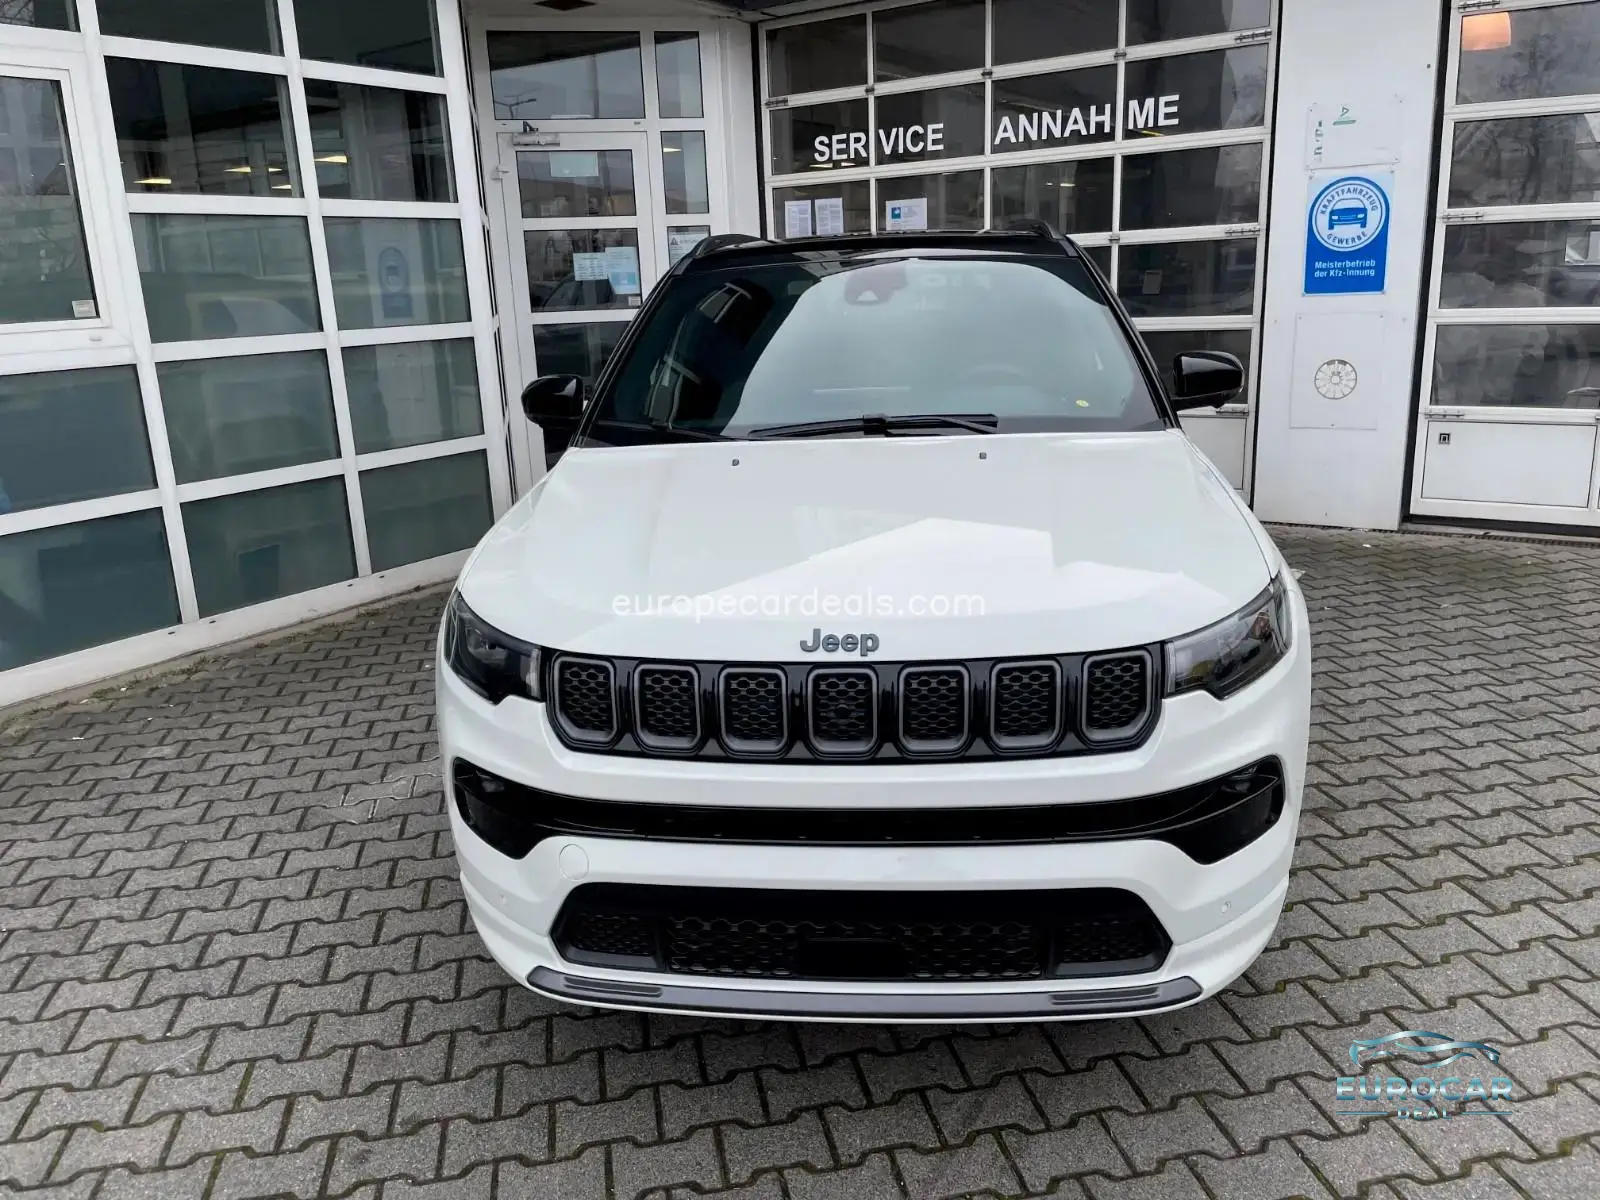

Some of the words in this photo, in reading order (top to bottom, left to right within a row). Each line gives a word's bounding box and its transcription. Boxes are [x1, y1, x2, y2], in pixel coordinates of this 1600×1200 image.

[814, 123, 944, 162] SERVICE
[994, 94, 1179, 145] ANNAHME
[1320, 187, 1378, 215] KRAFTFAHRZEUG
[1327, 231, 1368, 246] GEWERBE
[1314, 259, 1376, 269] Meisterbetrieb
[1314, 270, 1328, 278] der
[1329, 268, 1376, 277] Kfz-Innung
[800, 628, 880, 656] Jeep
